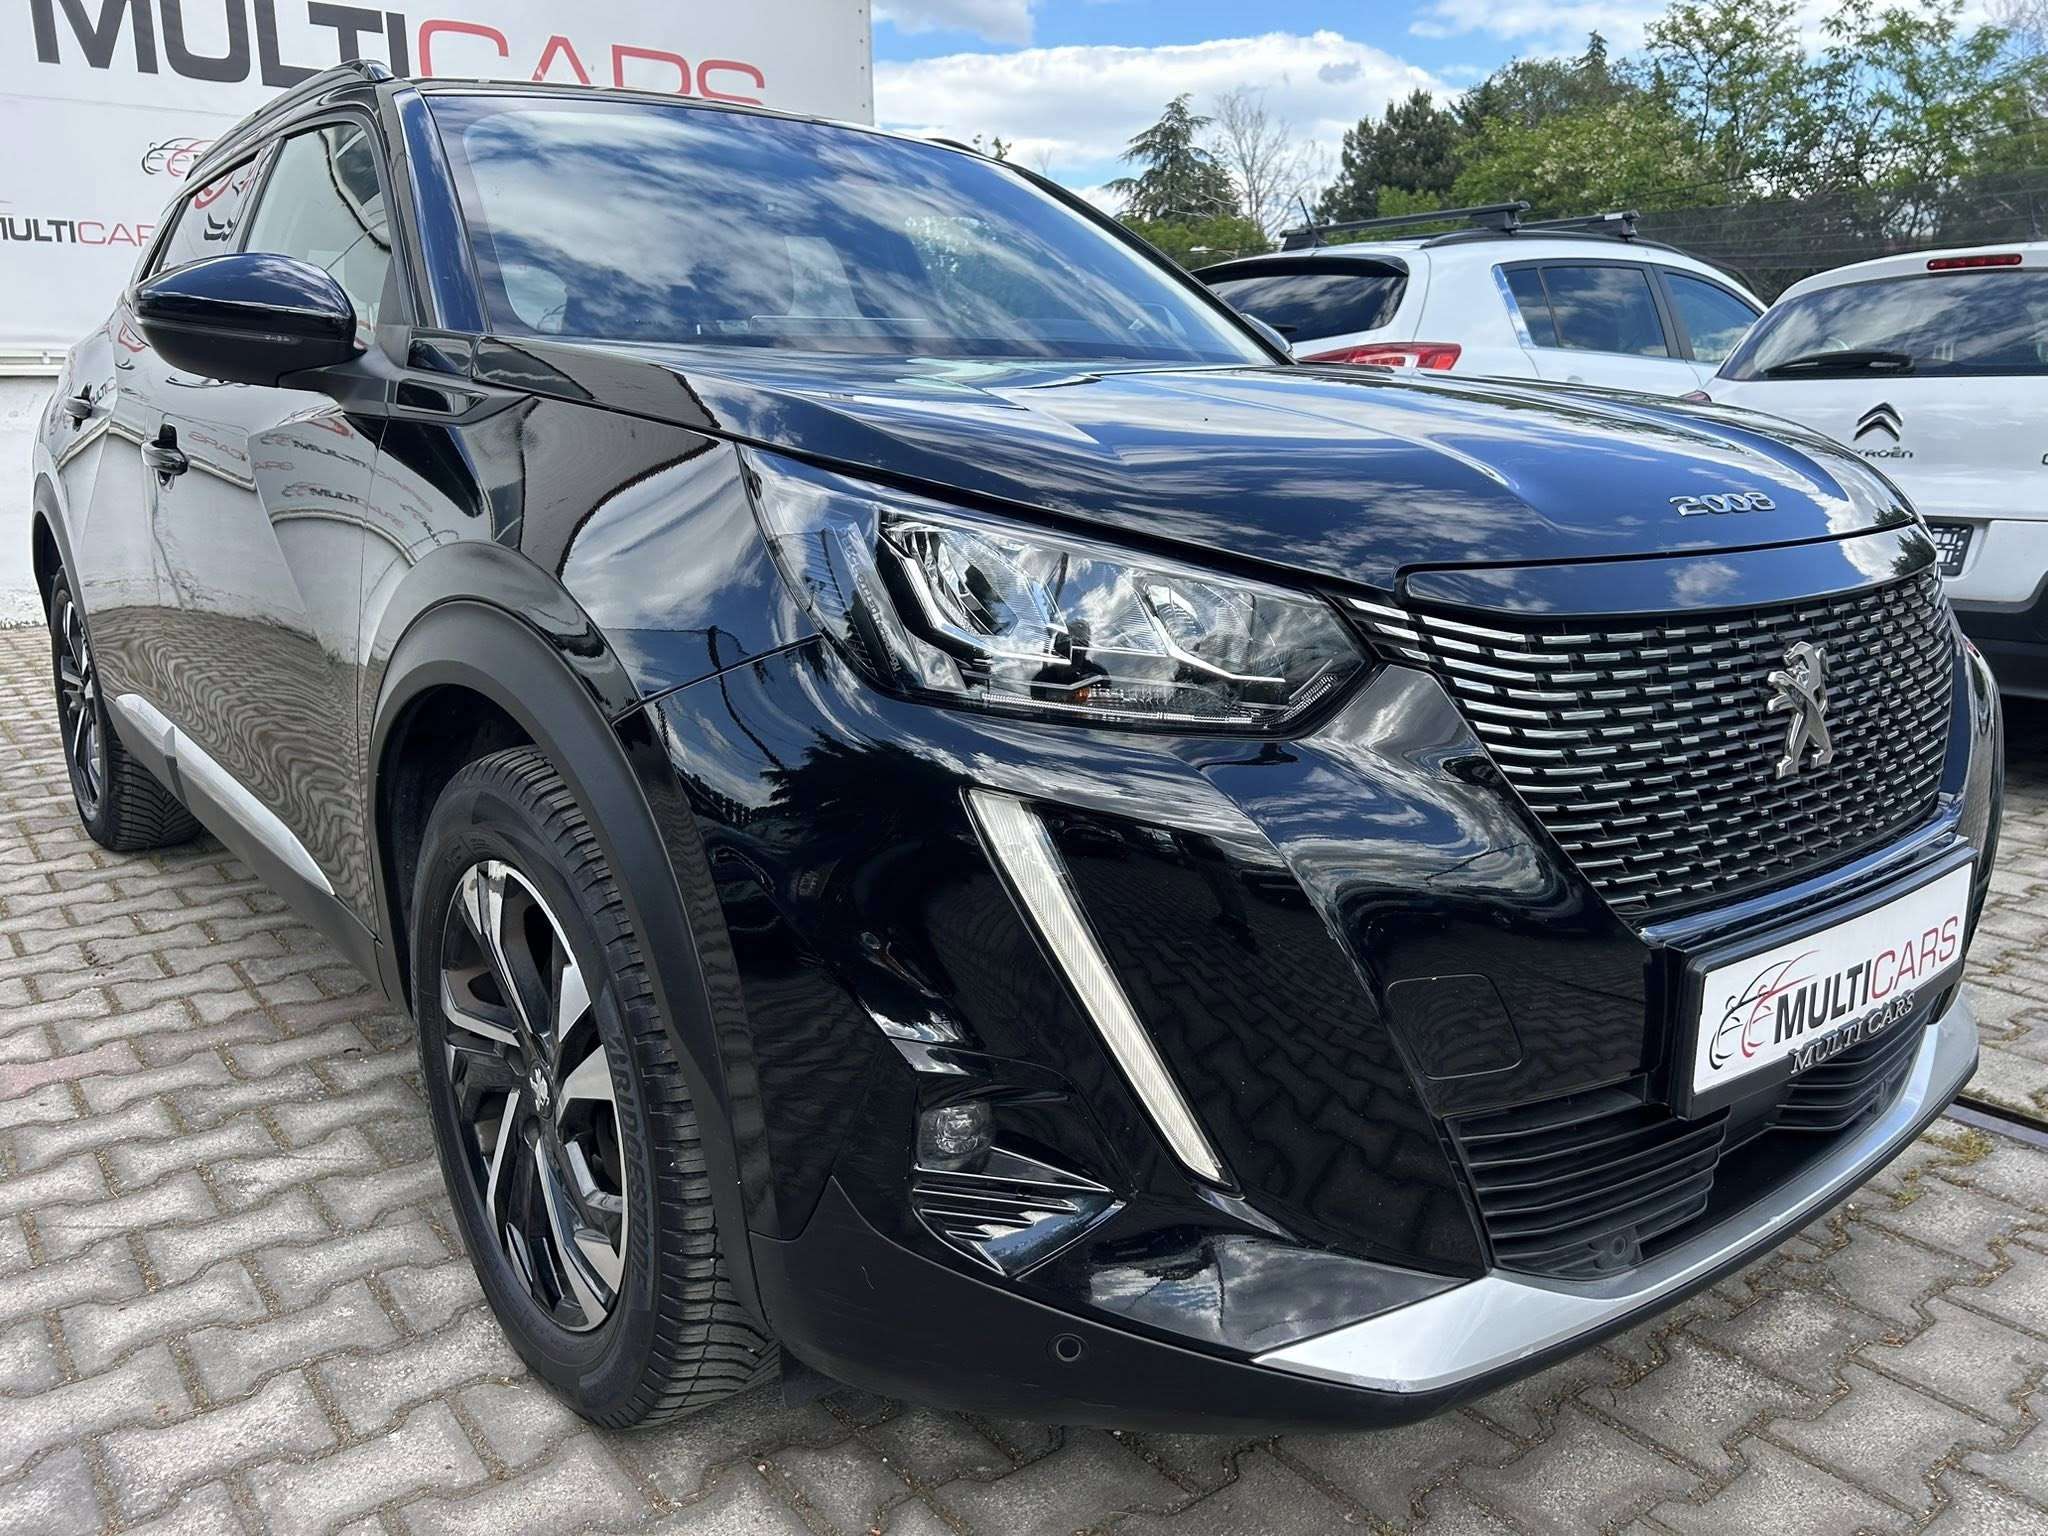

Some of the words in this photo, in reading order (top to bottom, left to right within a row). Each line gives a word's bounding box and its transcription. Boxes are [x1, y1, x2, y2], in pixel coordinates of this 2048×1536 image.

[1669, 491, 1776, 518] 2008
[1774, 915, 1958, 1045] MULTICARS
[1788, 1020, 1865, 1076] MULTI
[1867, 989, 1916, 1033] CARS
